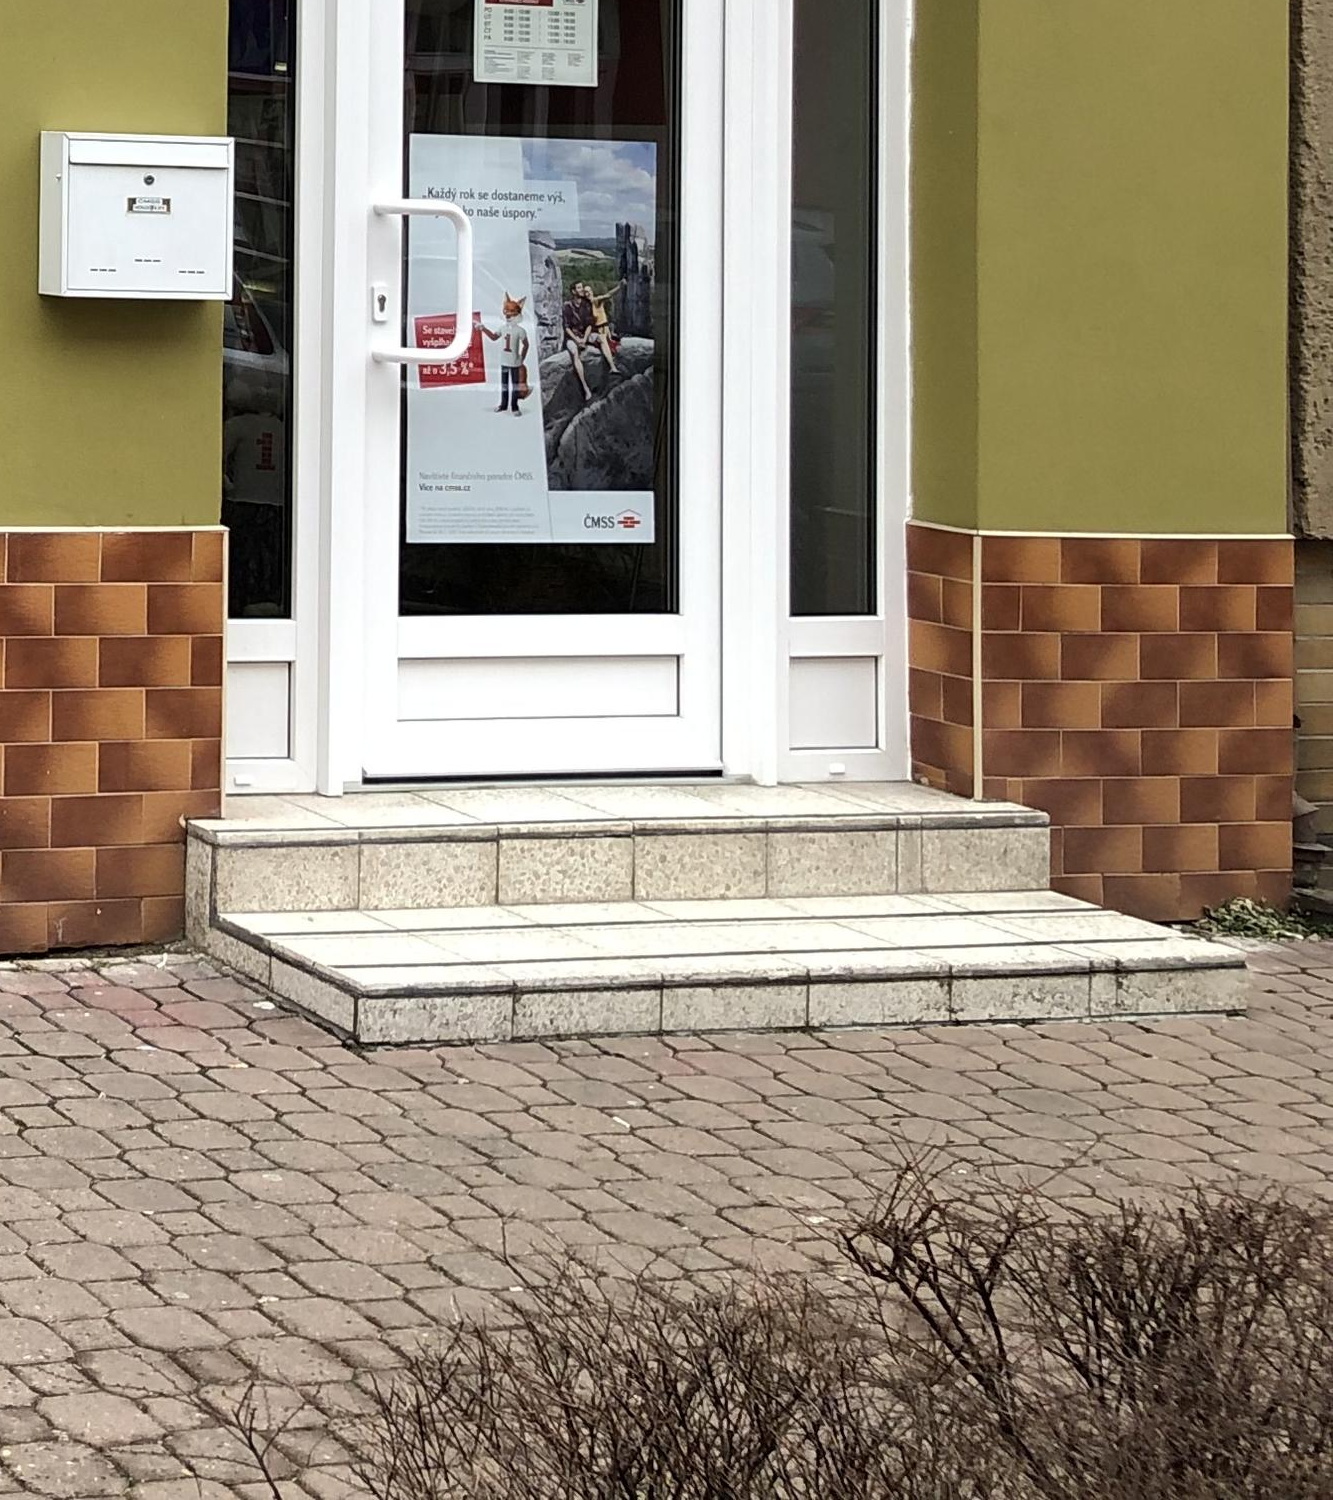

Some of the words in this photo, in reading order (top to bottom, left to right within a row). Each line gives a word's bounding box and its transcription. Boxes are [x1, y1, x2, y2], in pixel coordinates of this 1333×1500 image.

[459, 188, 476, 200] rok
[478, 191, 489, 200] se
[491, 190, 545, 202] dostaneme
[476, 206, 500, 218] naše
[583, 513, 616, 529] ČMSS
